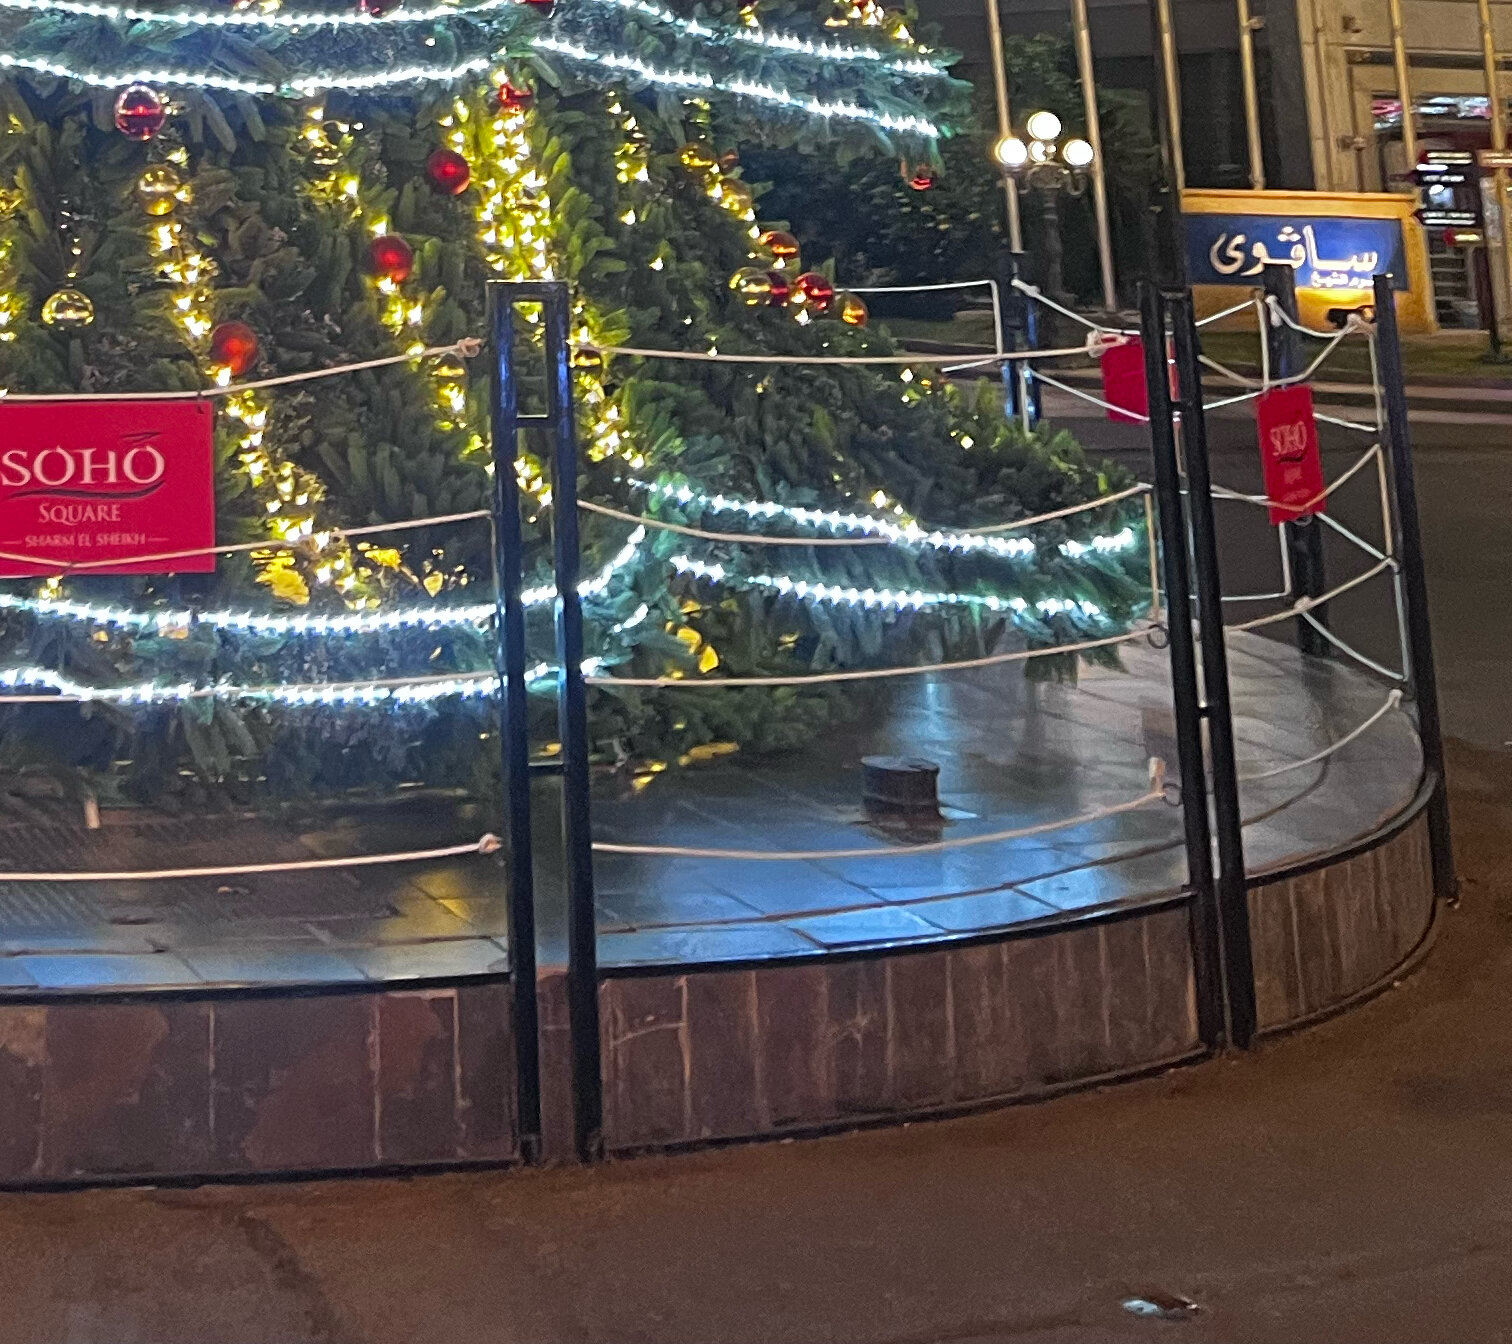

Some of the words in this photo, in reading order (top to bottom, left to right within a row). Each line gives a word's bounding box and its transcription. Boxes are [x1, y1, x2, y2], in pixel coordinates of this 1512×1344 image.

[39, 502, 121, 526] SQUARE
[25, 532, 75, 548] SHARM
[78, 532, 92, 547] EL
[96, 531, 146, 546] SHEIKH
